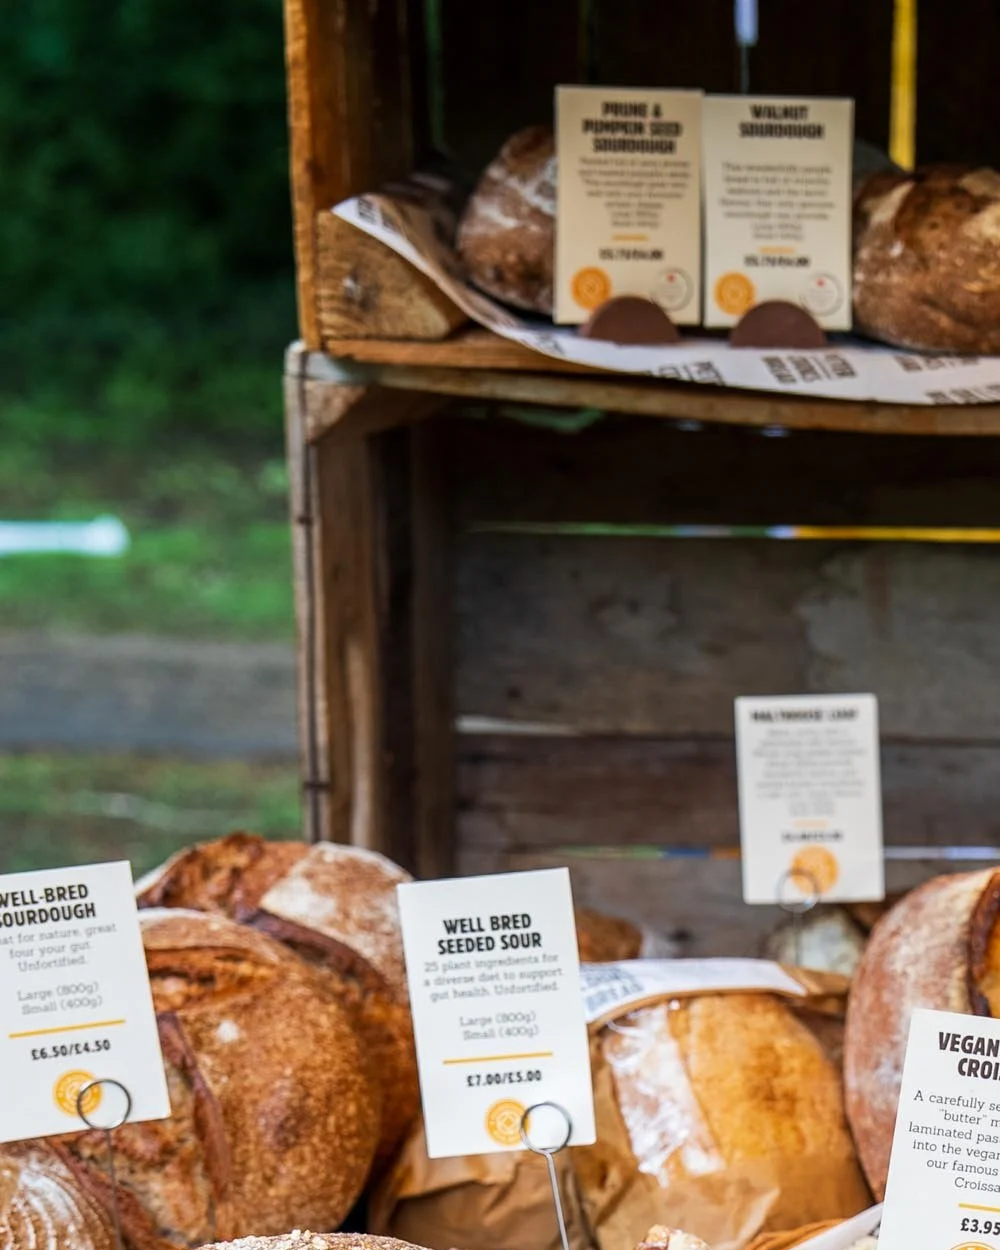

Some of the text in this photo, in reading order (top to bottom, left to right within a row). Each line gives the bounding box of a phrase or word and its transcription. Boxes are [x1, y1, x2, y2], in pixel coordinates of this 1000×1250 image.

[602, 102, 647, 117] PRUNE
[750, 105, 808, 120] WALNUT
[740, 122, 824, 139] SOURDOUGH
[0, 903, 96, 928] OURDOUGH
[443, 914, 531, 934] WELL BRED
[438, 932, 541, 955] SEEDED SOUR
[31, 1039, 110, 1060] £6.50/£4.50
[939, 1032, 1000, 1057] VEGAN
[914, 1090, 923, 1101] A
[929, 1095, 986, 1112] carefully
[909, 1121, 972, 1140] laminated
[913, 1140, 937, 1151] into
[942, 1143, 961, 1155] the
[927, 1160, 948, 1169] our
[952, 1160, 998, 1176] famous
[961, 1218, 1000, 1235] £3.95
